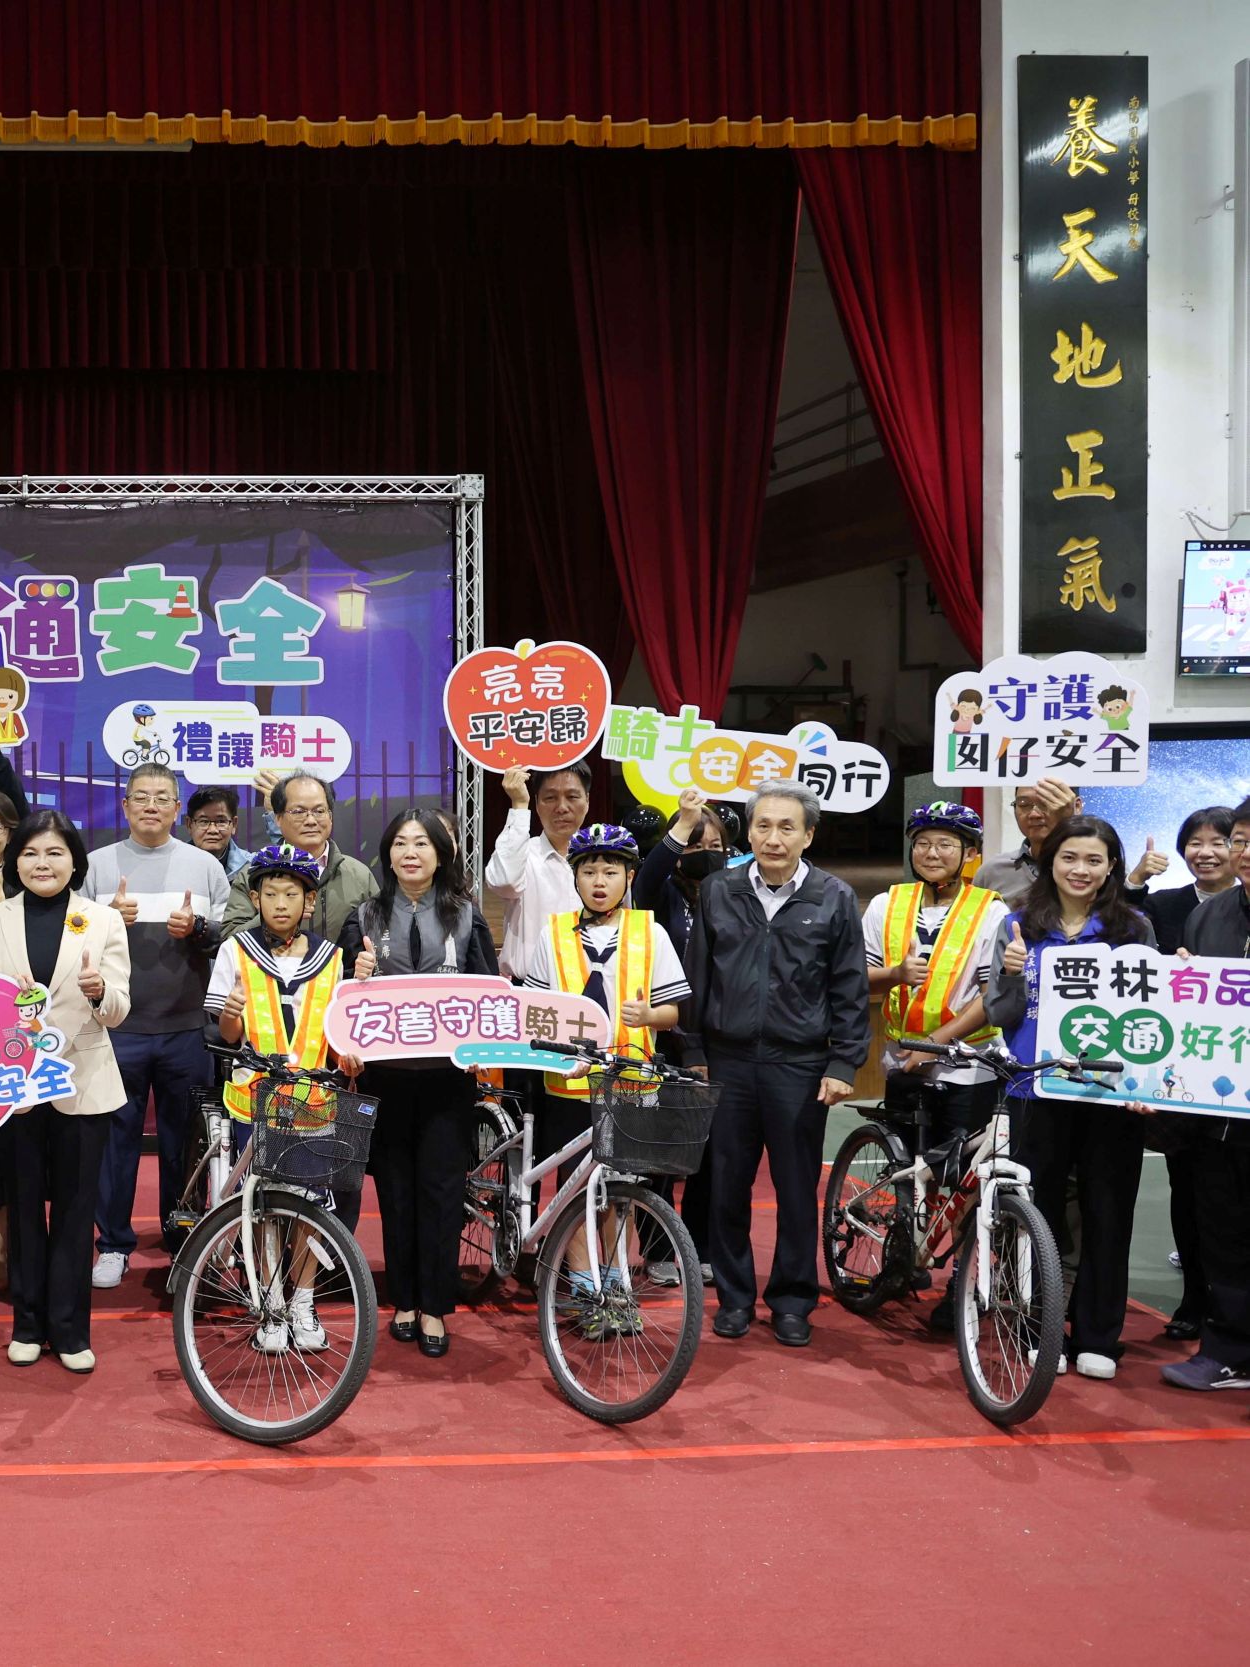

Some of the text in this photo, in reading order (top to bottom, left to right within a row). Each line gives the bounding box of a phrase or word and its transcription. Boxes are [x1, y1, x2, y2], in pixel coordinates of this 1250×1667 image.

[1049, 96, 1123, 614] 養天地正氣
[480, 663, 566, 706] 亮亮
[988, 673, 1095, 722] 守護
[172, 721, 336, 769] 禮讓騎士
[469, 706, 588, 750] 平安歸
[607, 708, 882, 801] 騎士安全同行
[947, 729, 1141, 778] 囡仔安全
[1052, 957, 1250, 1007] 雲林有品
[345, 993, 597, 1048] 友善守護騎士
